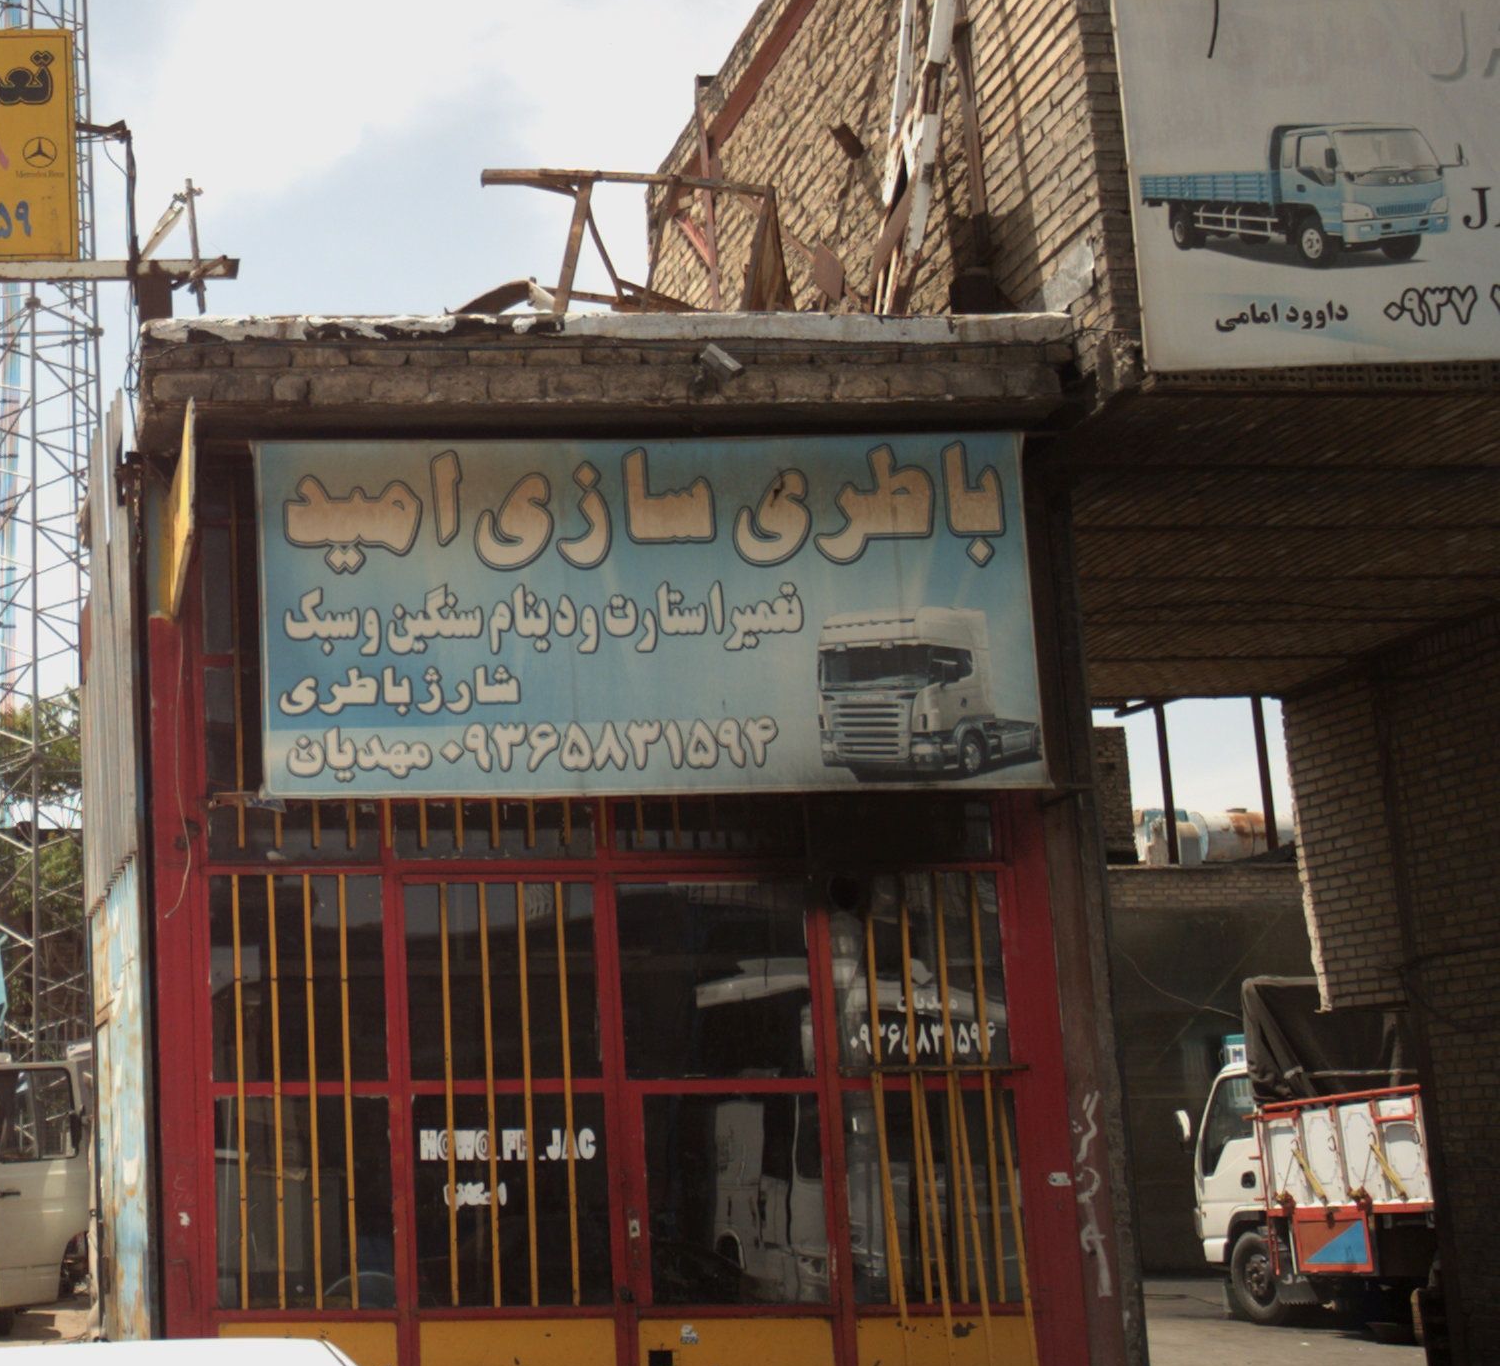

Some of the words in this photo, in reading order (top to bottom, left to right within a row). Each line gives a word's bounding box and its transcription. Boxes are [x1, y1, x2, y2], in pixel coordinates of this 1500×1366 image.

[1463, 187, 1500, 230] J
[1215, 302, 1278, 332] امامی
[1285, 301, 1349, 329] داوود
[283, 449, 463, 575] امید
[474, 446, 716, 573] سازی
[732, 440, 1007, 568] باطری
[284, 586, 360, 656] سبک
[359, 607, 382, 656] و
[386, 583, 483, 656] سنگین
[488, 582, 577, 656] دینام
[576, 603, 599, 654] و
[603, 580, 725, 654] استارت
[723, 581, 804, 652] تعمیر
[278, 665, 413, 717] باطری
[415, 664, 522, 714] شارژ
[286, 725, 433, 783] مهدیان
[439, 716, 779, 773] ۰۹۳۶۵۸۳۱۵۹۴
